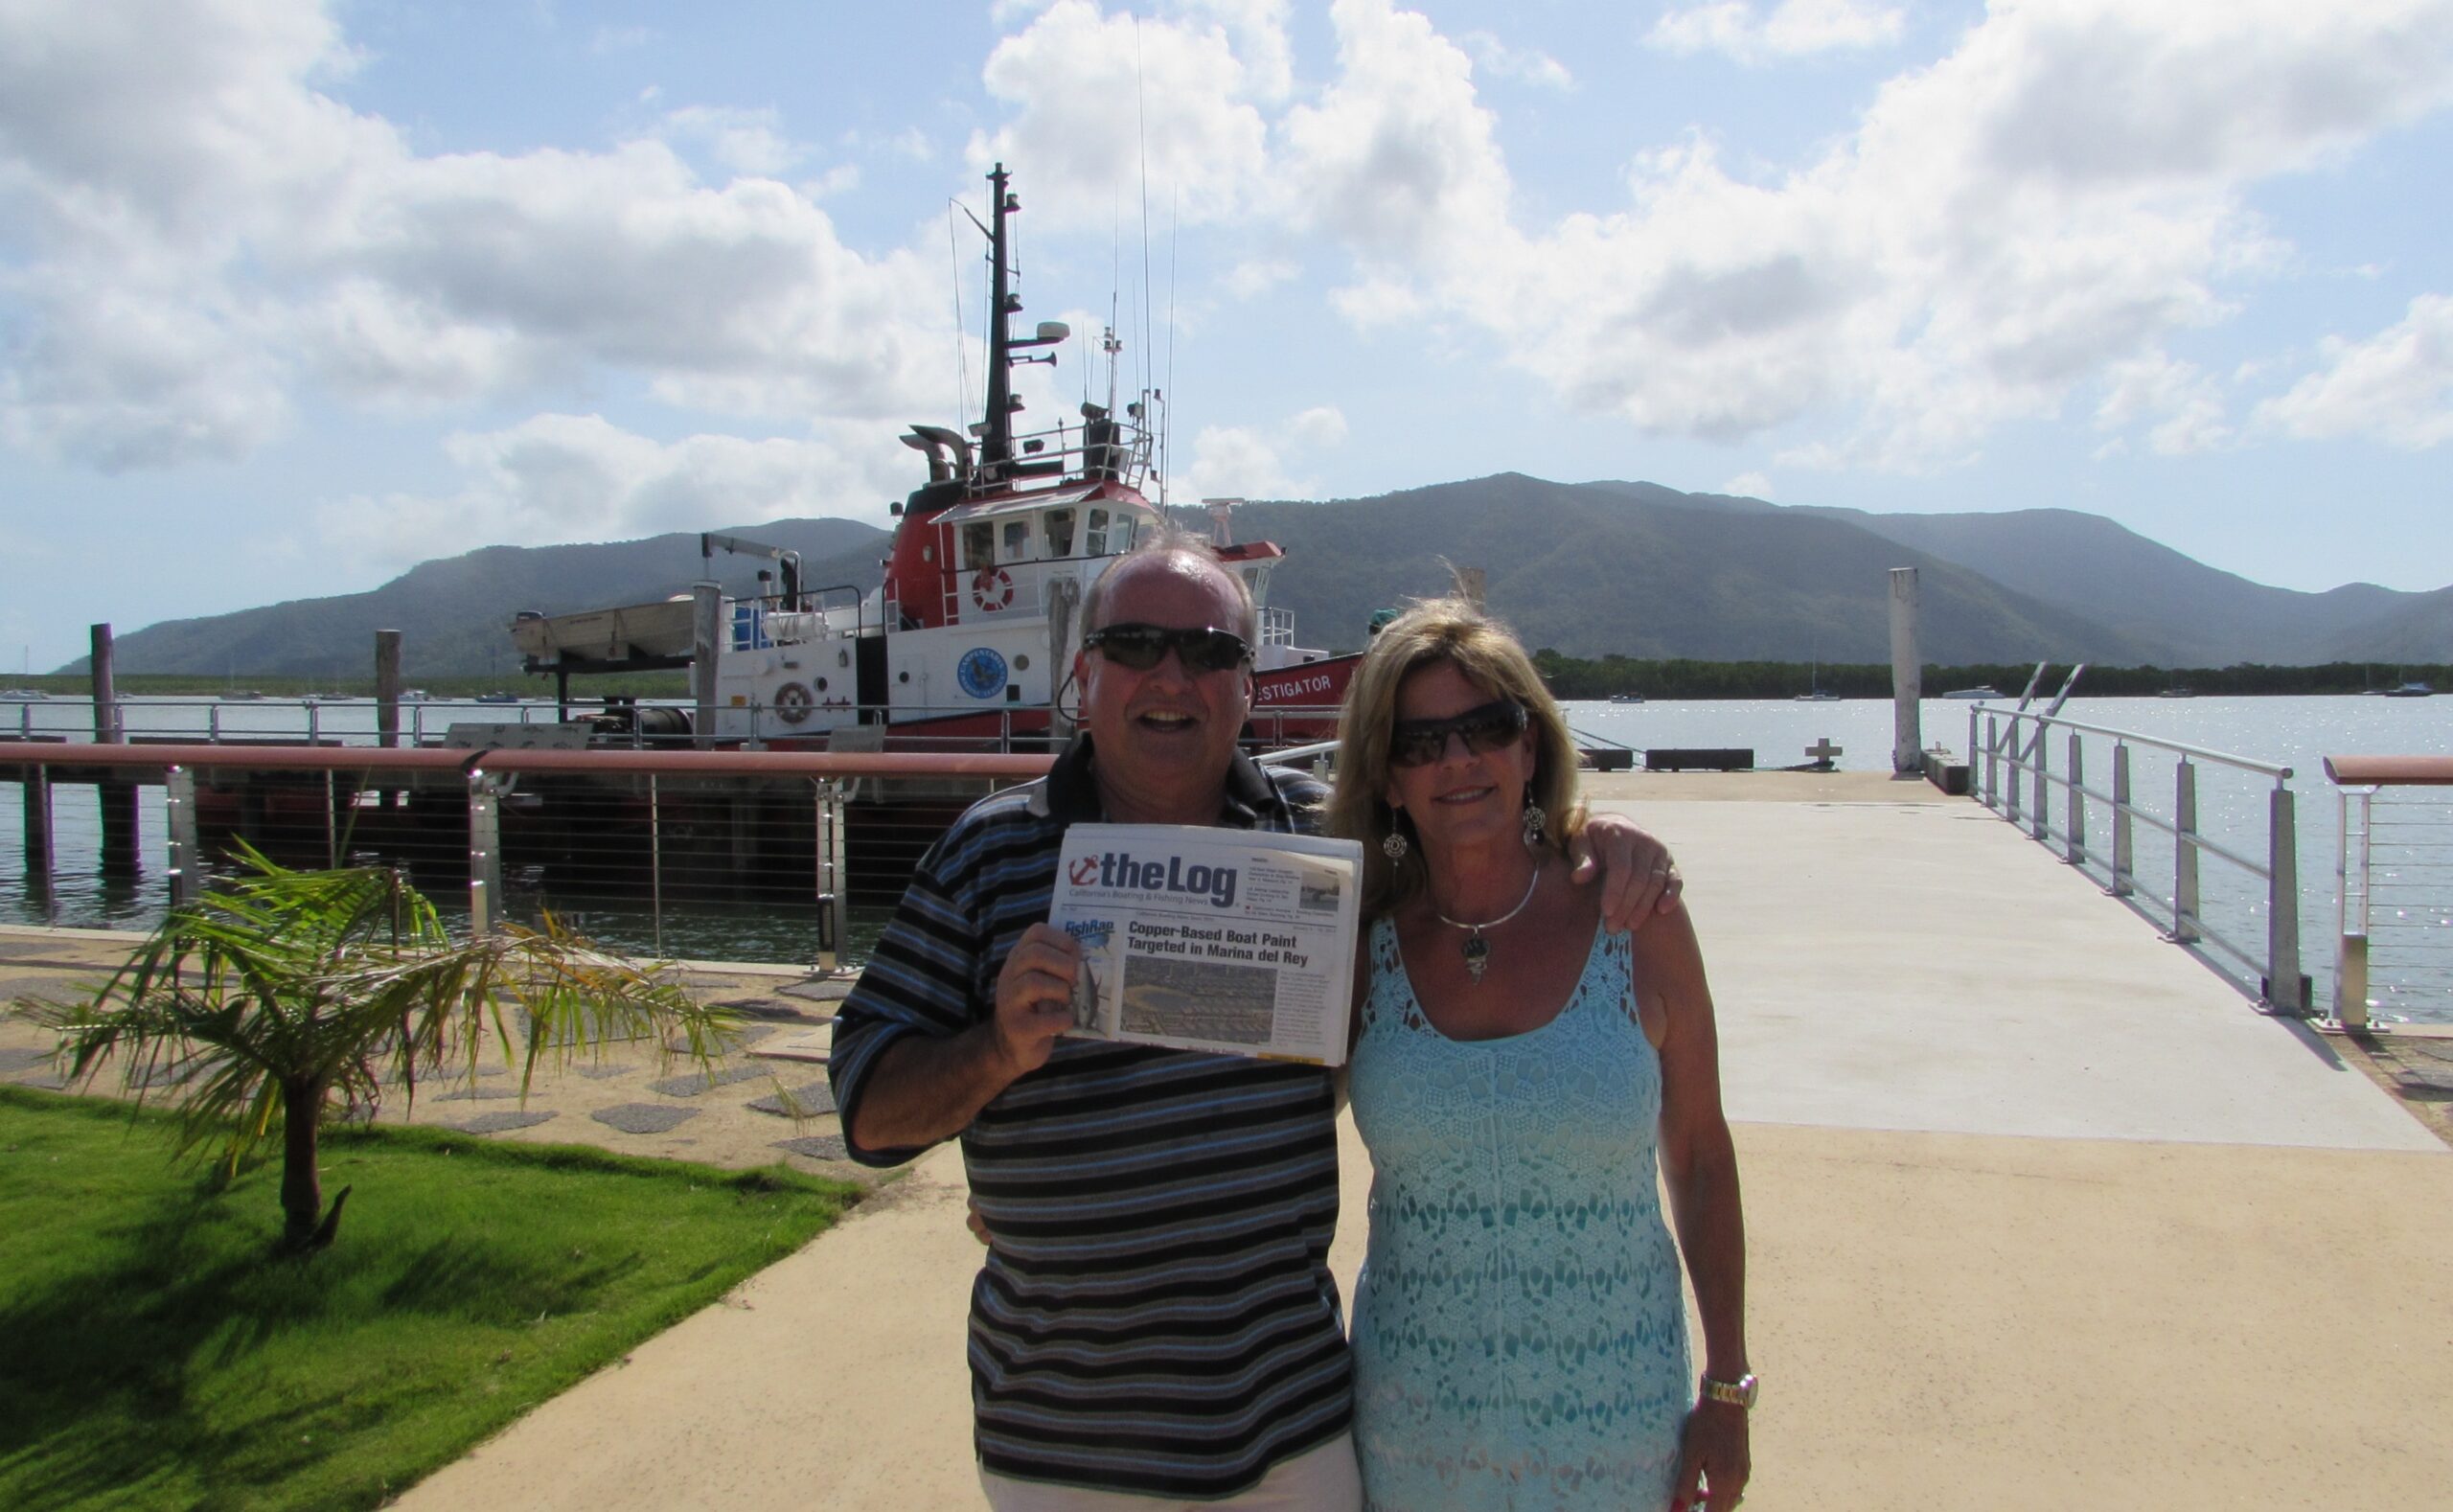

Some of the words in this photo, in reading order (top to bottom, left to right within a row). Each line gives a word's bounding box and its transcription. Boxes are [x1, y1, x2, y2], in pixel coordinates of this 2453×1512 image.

[1068, 888, 1111, 898] California's
[1112, 891, 1144, 902] Boating
[1154, 894, 1183, 905] Fishing
[1184, 897, 1208, 905] News
[1128, 921, 1222, 941] Copper-Based
[1226, 929, 1257, 945] Boat
[1262, 932, 1296, 948] Paint
[1128, 936, 1185, 954] Targeted
[1190, 943, 1203, 955] in
[1207, 944, 1252, 960] Marina
[1257, 949, 1278, 963] del
[1283, 951, 1309, 968] Rey
